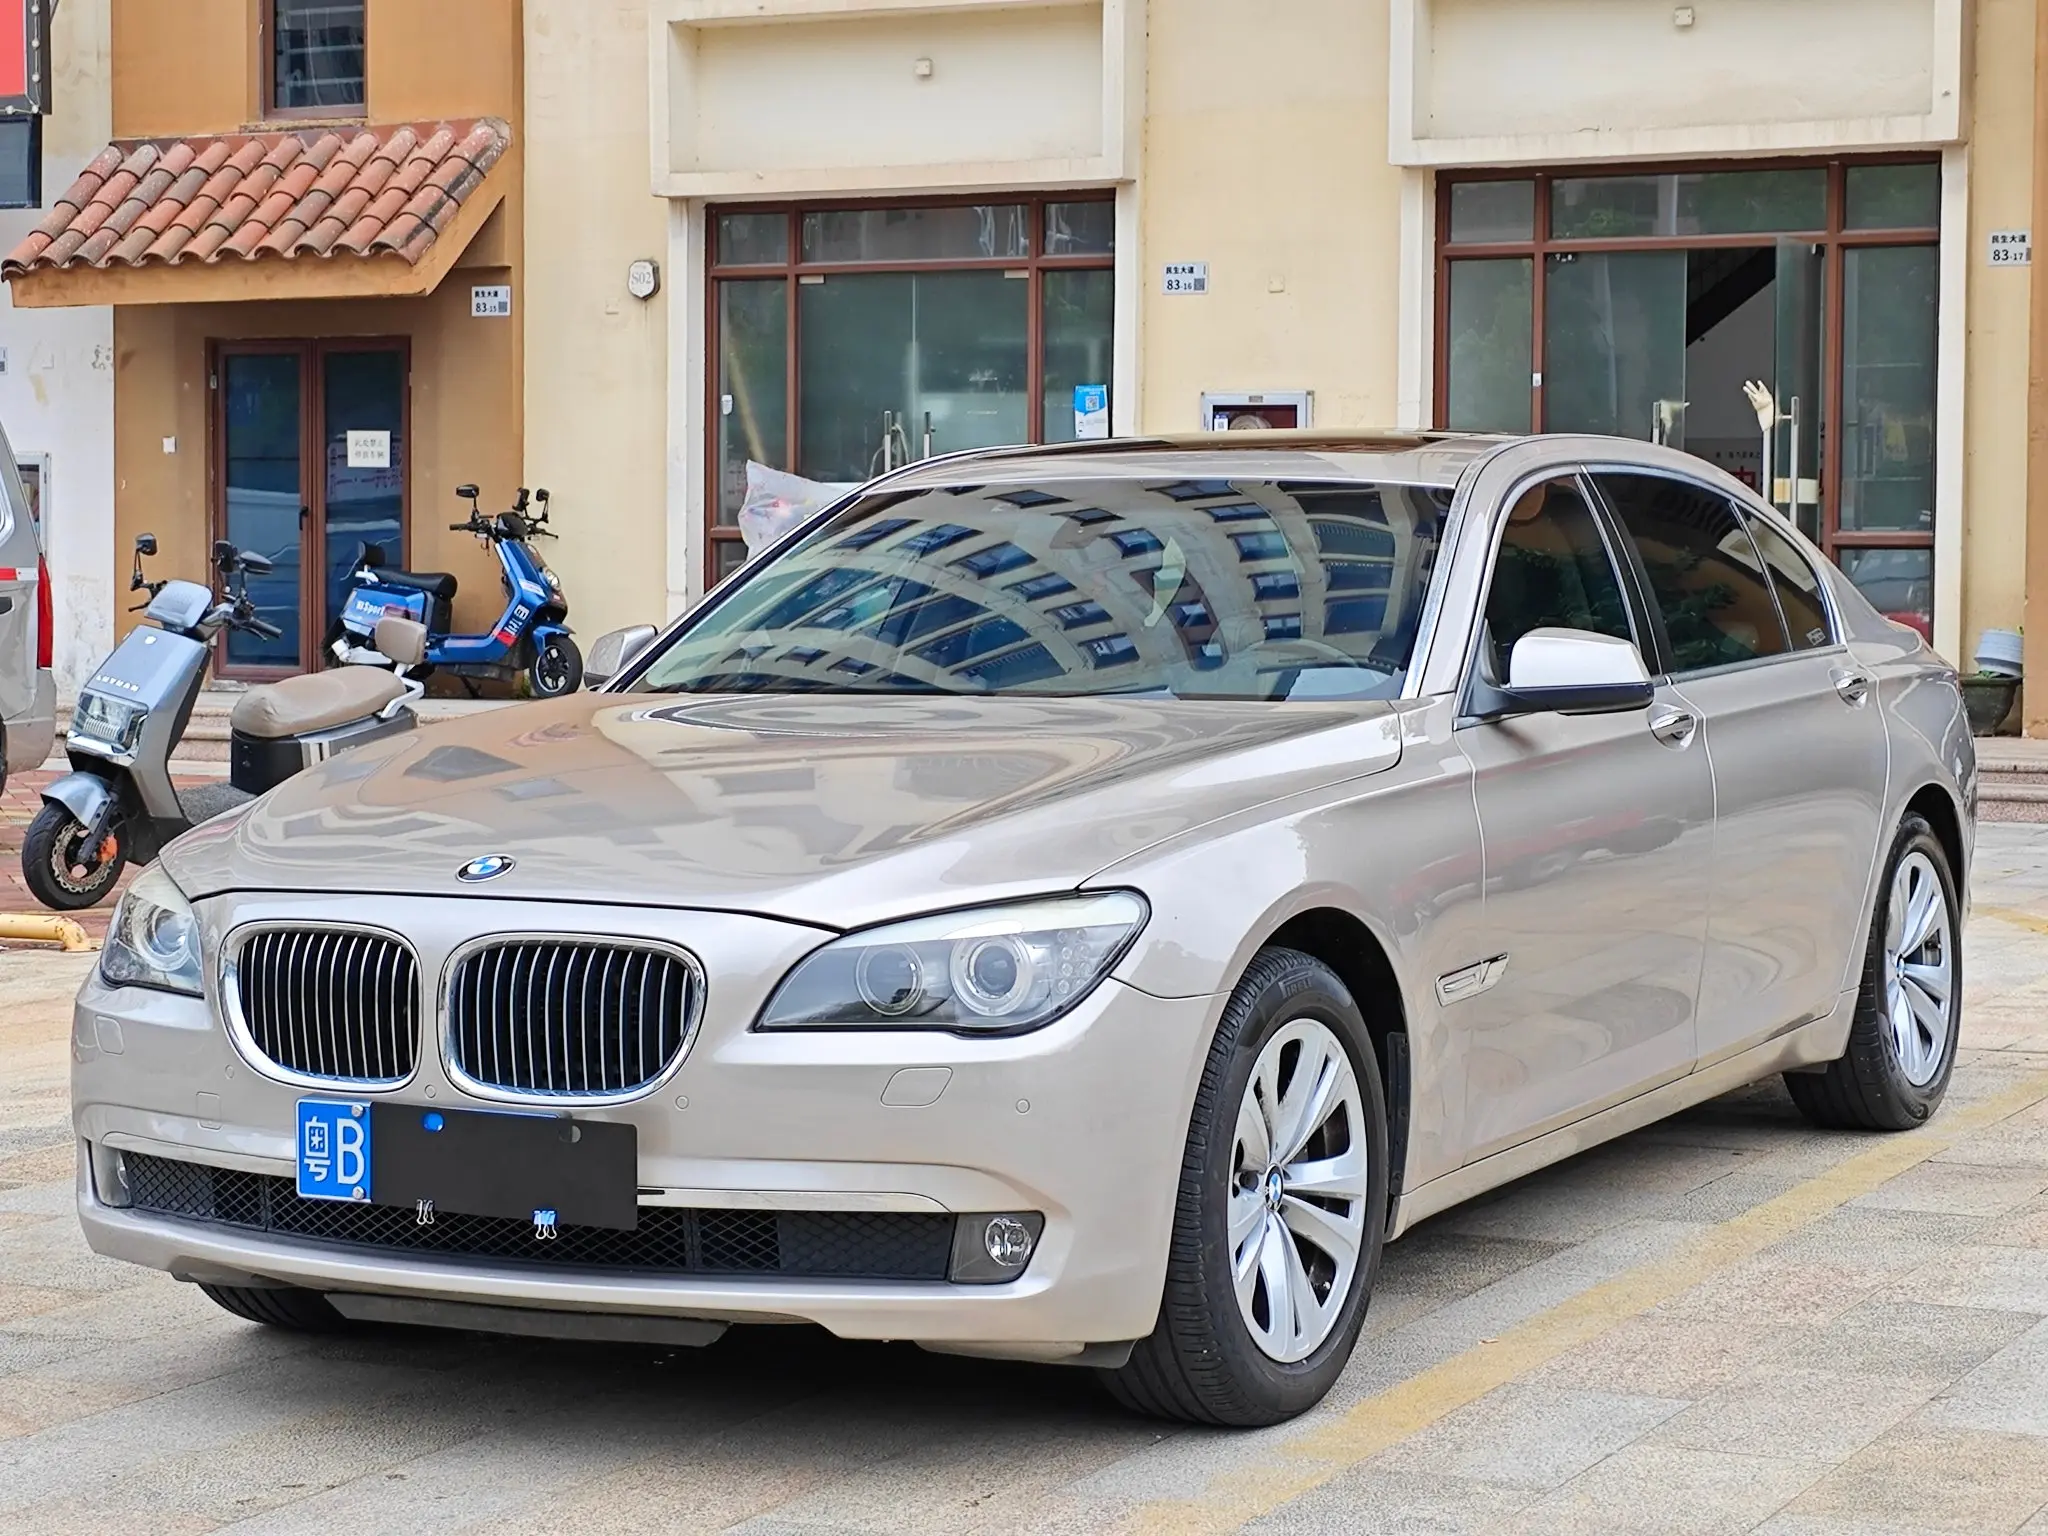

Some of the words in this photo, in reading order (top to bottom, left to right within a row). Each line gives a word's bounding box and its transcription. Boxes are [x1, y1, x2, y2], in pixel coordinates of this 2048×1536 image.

[1991, 234, 2027, 244] 民生大道
[1992, 249, 2024, 261] 83-17
[1166, 279, 1193, 291] 83-16
